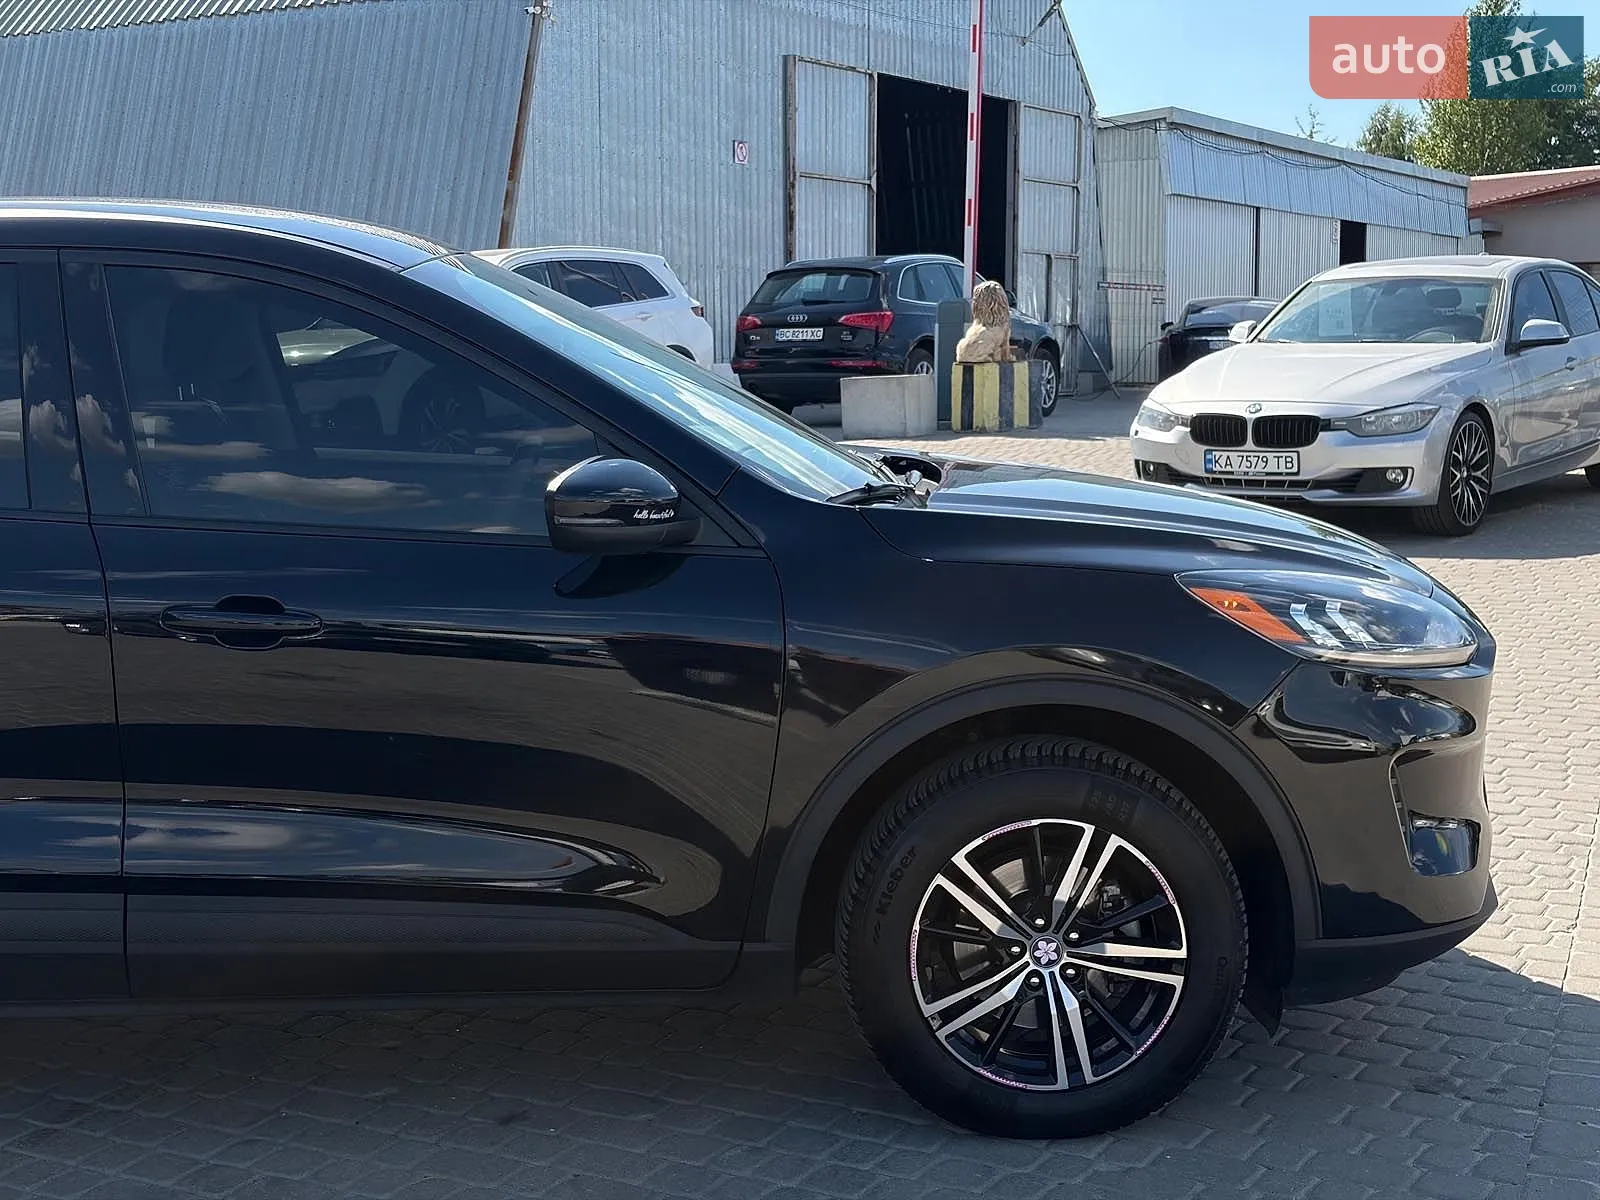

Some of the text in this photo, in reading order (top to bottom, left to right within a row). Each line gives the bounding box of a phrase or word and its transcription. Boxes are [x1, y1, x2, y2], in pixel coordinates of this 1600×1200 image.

[1214, 454, 1294, 470] KA 7579 TB
[875, 844, 917, 917] Kleber
